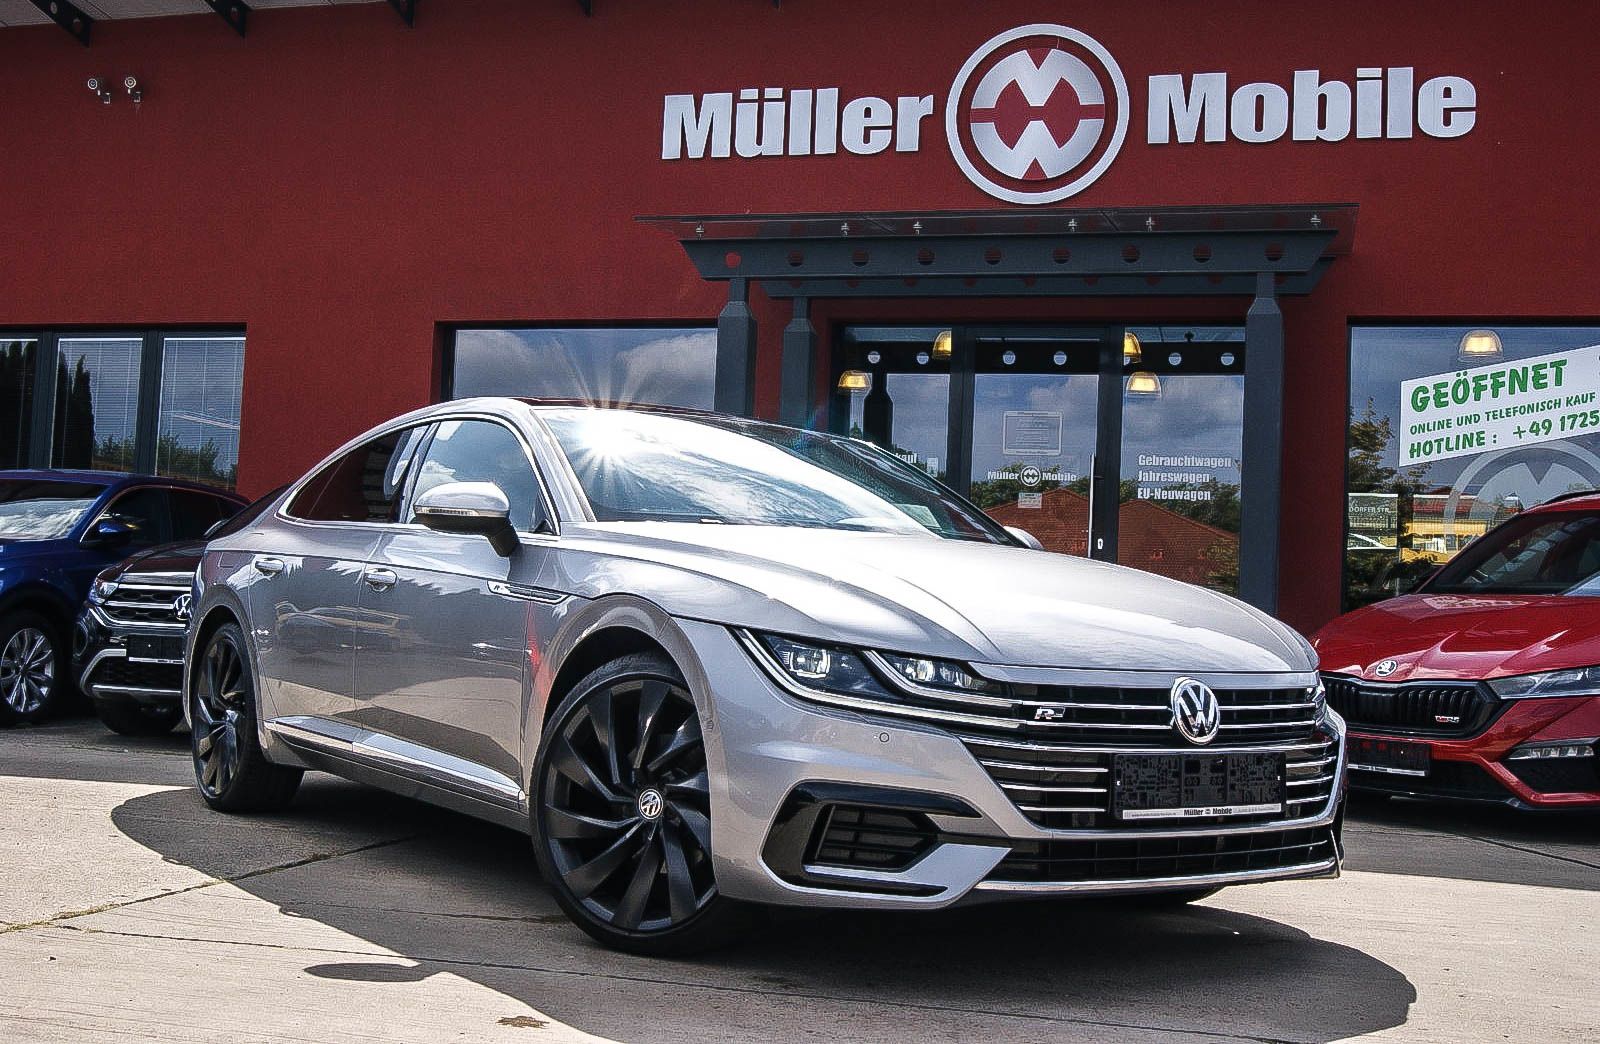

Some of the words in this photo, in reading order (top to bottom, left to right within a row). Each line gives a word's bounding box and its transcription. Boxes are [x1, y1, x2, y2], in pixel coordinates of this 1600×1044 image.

[661, 87, 934, 160] Müller
[1147, 66, 1477, 145] Mobile
[1410, 359, 1568, 412] GEÖFFNET
[1410, 418, 1452, 435] ONLINE
[1457, 413, 1480, 427] UND
[1485, 398, 1561, 421] TELEFONISCH
[1566, 392, 1596, 407] KAUF
[1409, 431, 1486, 458] HOTLINE
[1513, 419, 1552, 439] +49
[1138, 454, 1232, 468] Gebrauchtwagen
[987, 470, 1019, 480] Müller
[1042, 472, 1077, 481] Mobile
[1138, 470, 1210, 483] Jahreswagen
[1137, 487, 1211, 501] EU-Neuwagen
